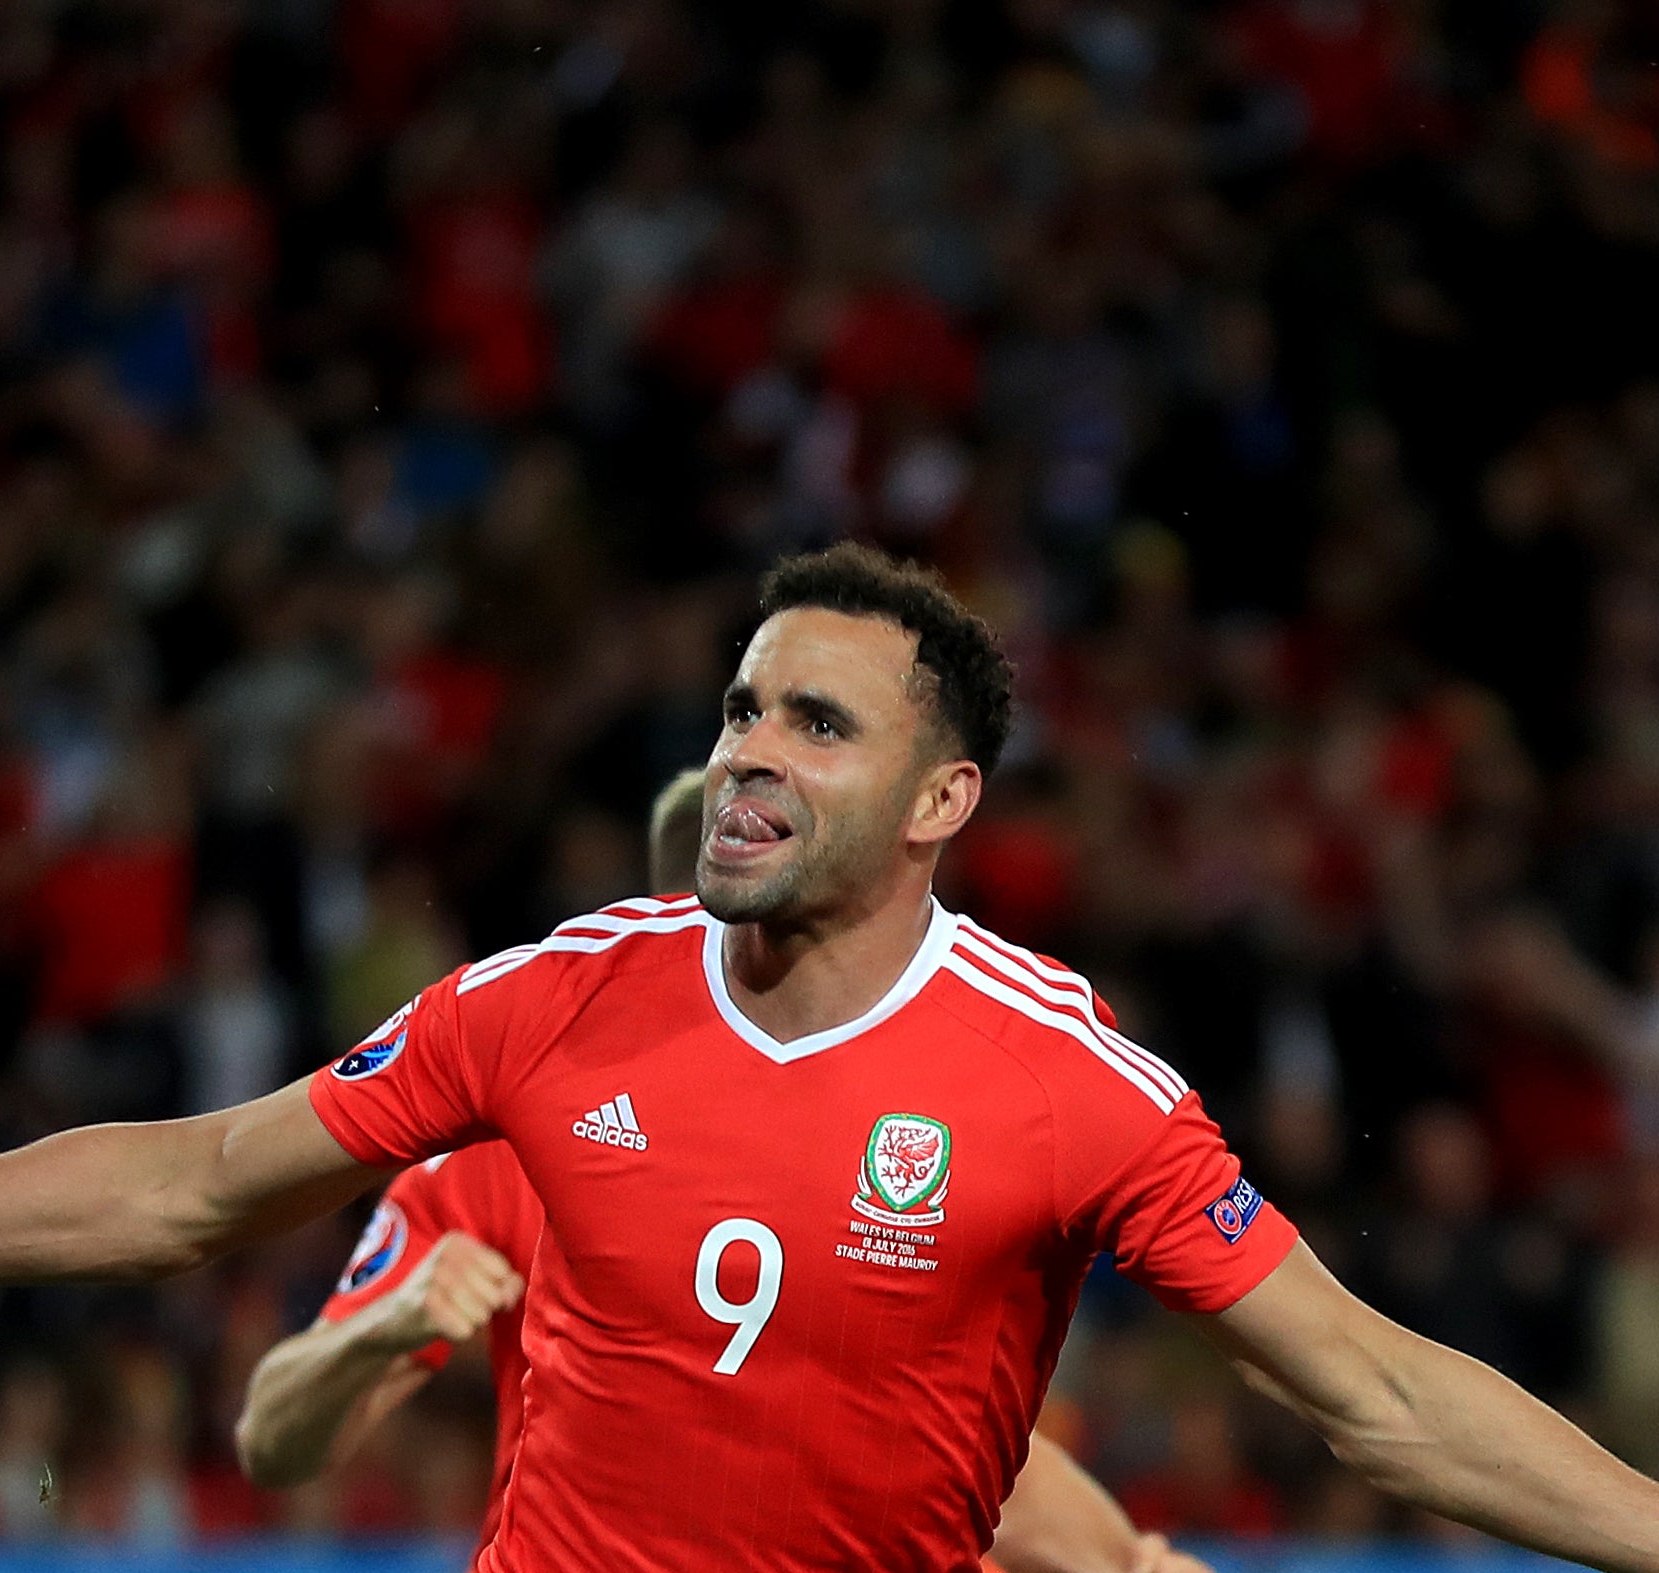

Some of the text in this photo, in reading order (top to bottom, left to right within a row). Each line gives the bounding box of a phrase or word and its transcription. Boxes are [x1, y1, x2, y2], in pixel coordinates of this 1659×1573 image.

[572, 1120, 649, 1151] adidas
[850, 1220, 935, 1246] WALES VS BELGIUM
[835, 1244, 939, 1271] STADE PIERRE MAUROY
[872, 1239, 896, 1252] JULY
[897, 1243, 916, 1256] 2016
[694, 1217, 784, 1375] 9
